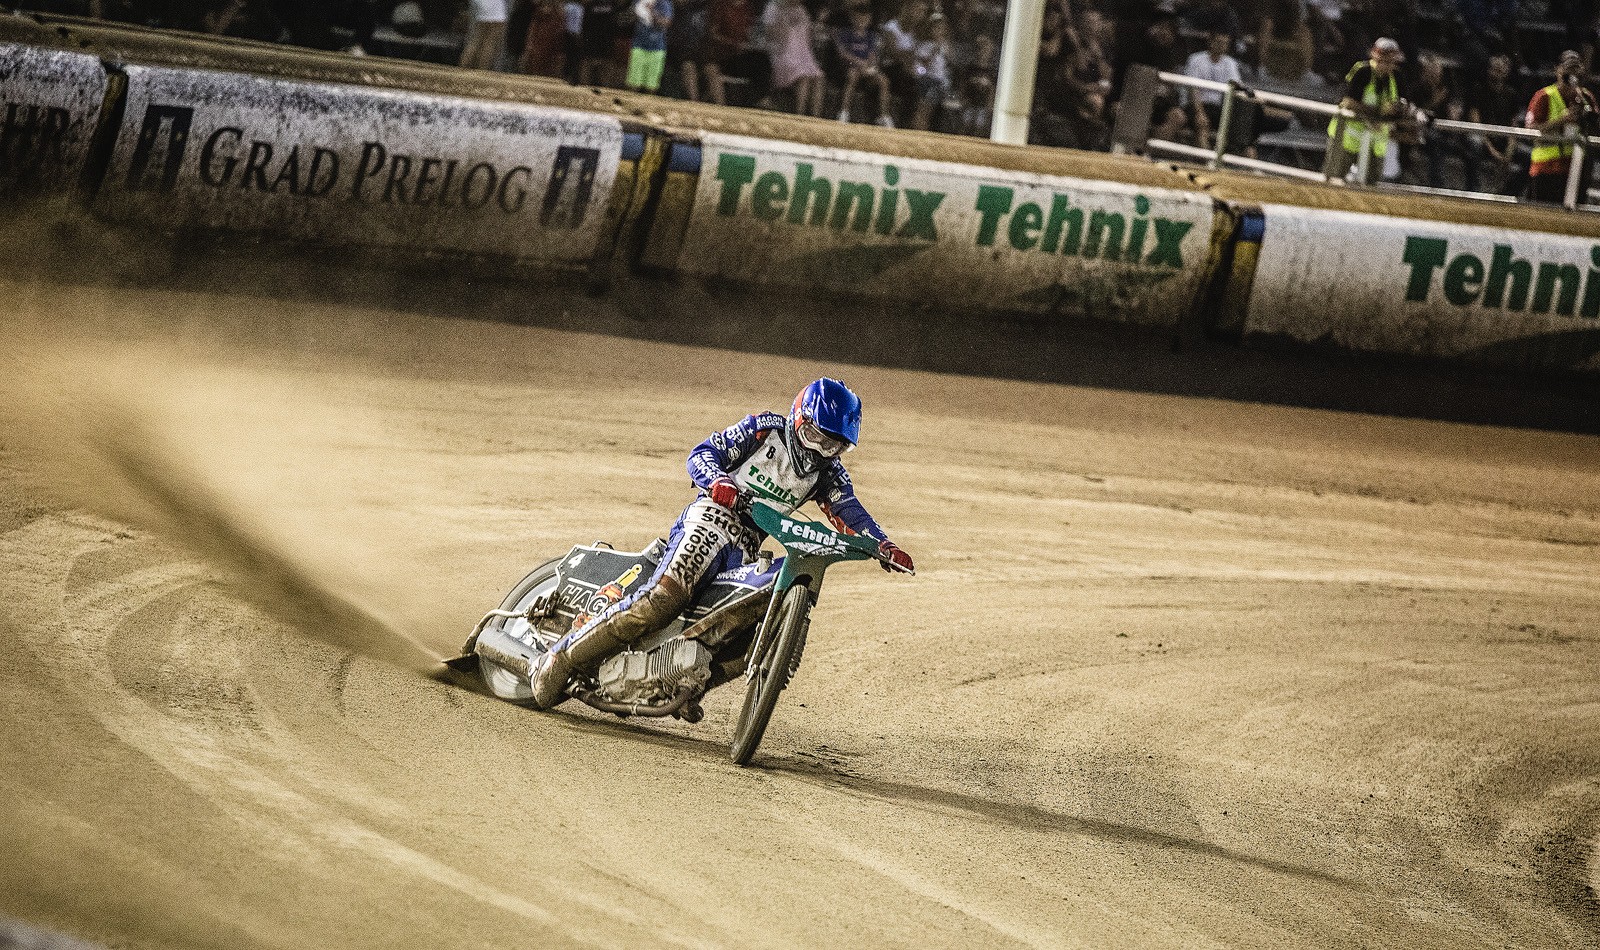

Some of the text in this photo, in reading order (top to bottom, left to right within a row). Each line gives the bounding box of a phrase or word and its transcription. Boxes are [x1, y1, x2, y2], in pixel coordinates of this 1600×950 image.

[716, 153, 1193, 269] Tehnix Tehnix
[1403, 236, 1600, 318] Tehni
[748, 465, 799, 505] Tehnix
[568, 553, 586, 569] 4
